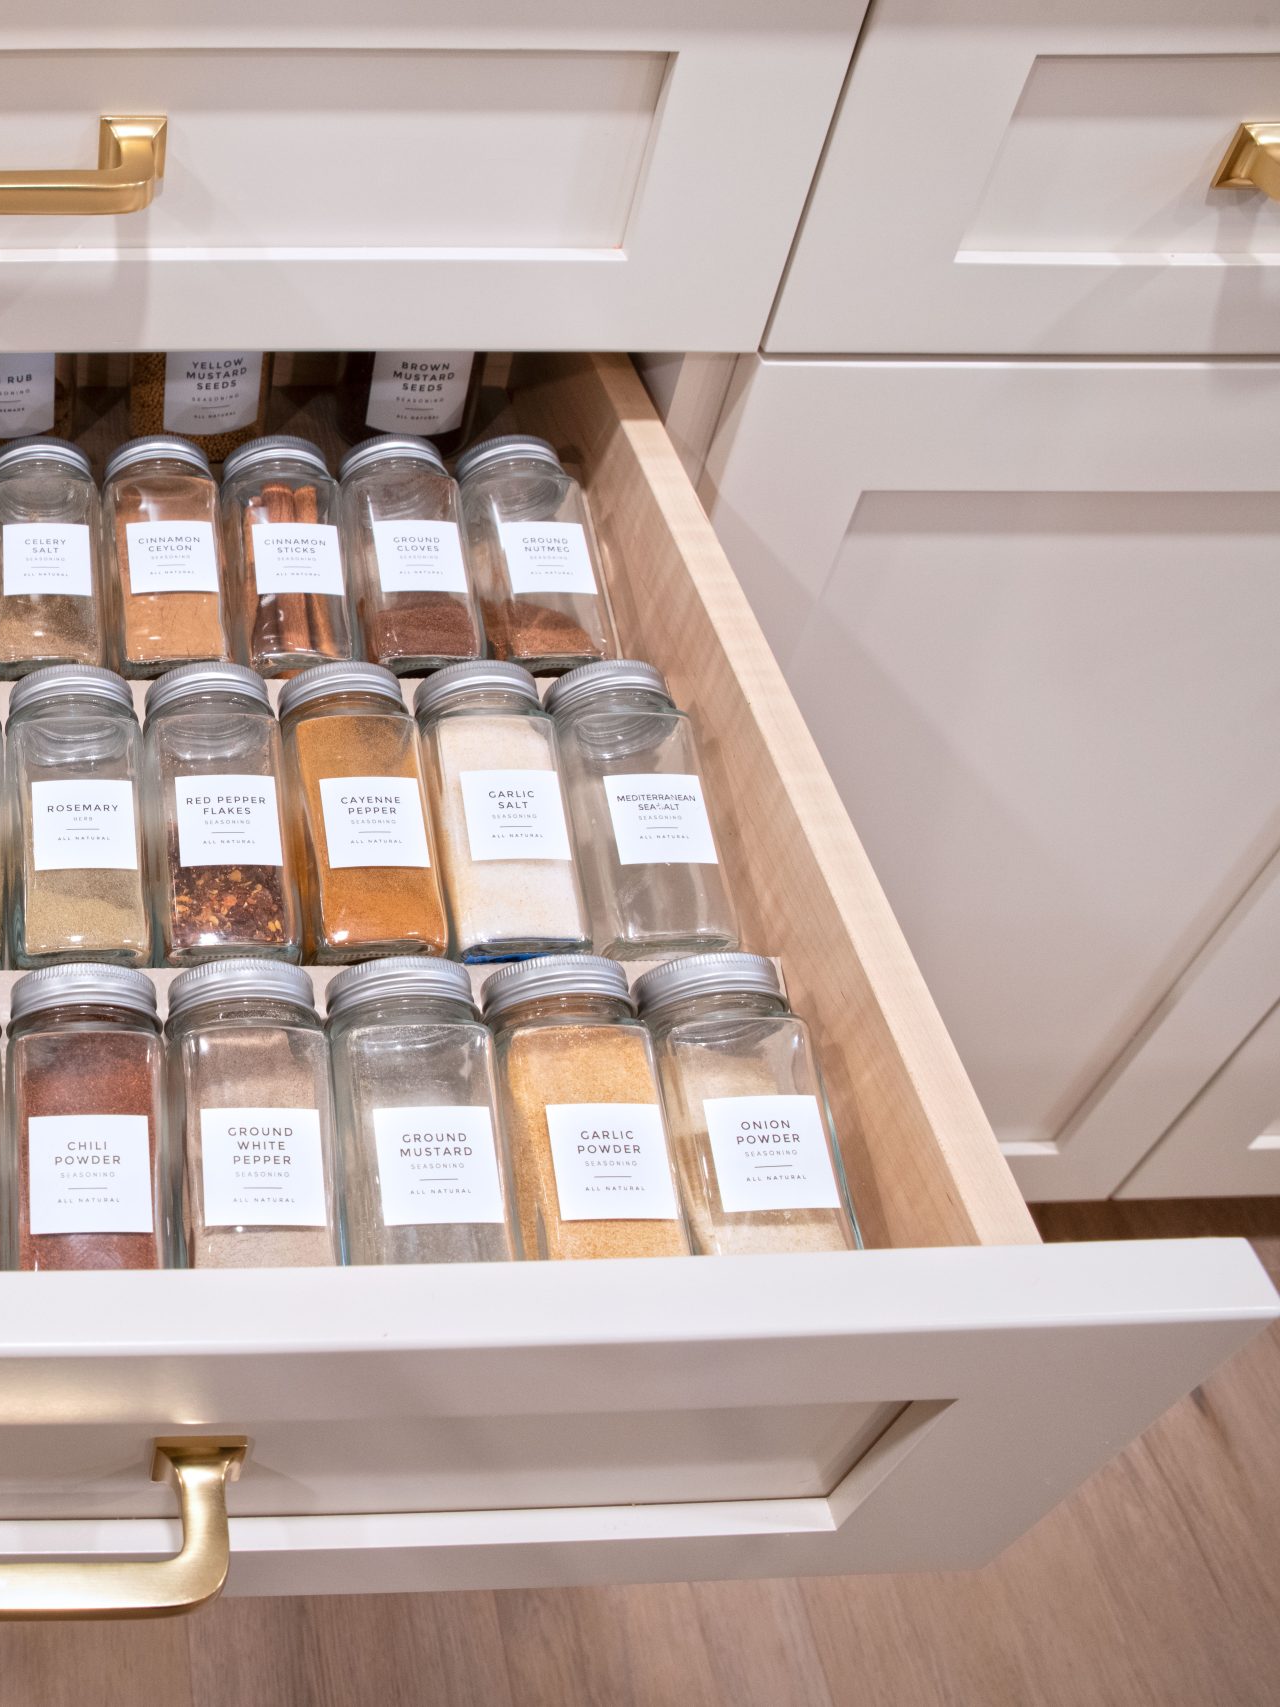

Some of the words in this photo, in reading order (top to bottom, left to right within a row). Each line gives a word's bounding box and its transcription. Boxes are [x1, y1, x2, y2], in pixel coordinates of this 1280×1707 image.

[192, 358, 243, 370] YELLOW
[401, 361, 450, 372] BROWN
[186, 366, 248, 380] MUSTARD
[393, 370, 455, 382] MUSTARD
[7, 374, 32, 384] RUB
[196, 379, 237, 390] SEEDS
[402, 382, 442, 392] SEEDS
[138, 536, 200, 544] CINNAMON
[264, 538, 326, 546] CINNAMON
[522, 537, 568, 545] GROUND
[148, 544, 192, 552] CEYLON
[277, 546, 316, 554] STICKS
[488, 790, 534, 798] GARLIC
[616, 794, 696, 802] MEDITERRANEAN
[186, 796, 211, 805] RED
[217, 796, 266, 804] PEPPER
[340, 796, 400, 804] CAYENNE
[47, 804, 118, 812] ROSEMARY
[498, 801, 528, 809] SALT
[638, 802, 656, 811] SEA
[203, 807, 251, 815] FLAKES
[348, 806, 396, 815] PEPPER
[740, 1120, 790, 1131] ONION
[227, 1126, 293, 1137] GROUND
[580, 1130, 634, 1140] GARLIC
[402, 1132, 467, 1143] GROUND
[736, 1133, 800, 1145] POWDER
[67, 1141, 107, 1151] CHILI
[237, 1141, 285, 1151] WHITE
[577, 1144, 641, 1154] POWDER
[400, 1146, 472, 1157] MUSTARD
[744, 1149, 798, 1158] SEASONING
[54, 1155, 120, 1166] POWDER
[233, 1155, 291, 1165] PEPPER
[410, 1162, 465, 1170] SEASONING
[60, 1171, 116, 1179] SEASONING
[235, 1170, 290, 1178] SEASONING
